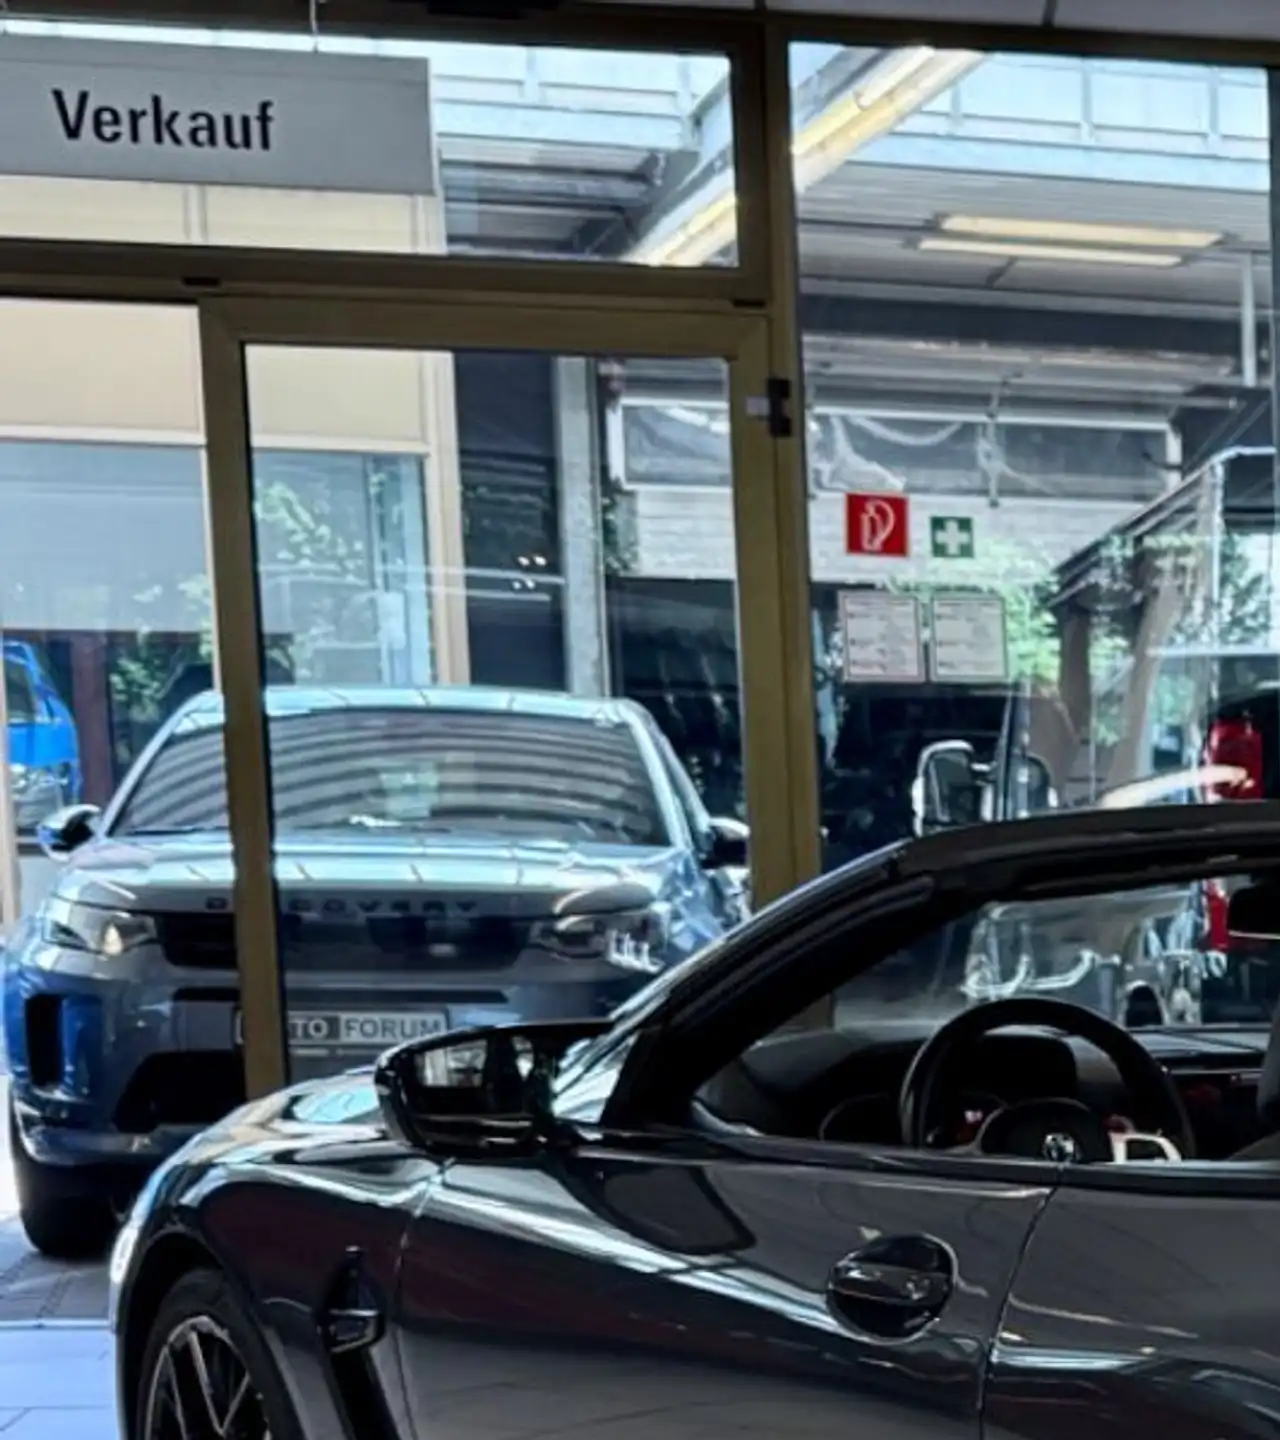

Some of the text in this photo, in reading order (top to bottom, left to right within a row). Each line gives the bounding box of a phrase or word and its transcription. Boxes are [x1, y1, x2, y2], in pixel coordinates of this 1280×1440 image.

[52, 88, 274, 151] Verkauf
[205, 897, 477, 915] DCOVERY
[344, 1018, 440, 1040] FORUM
